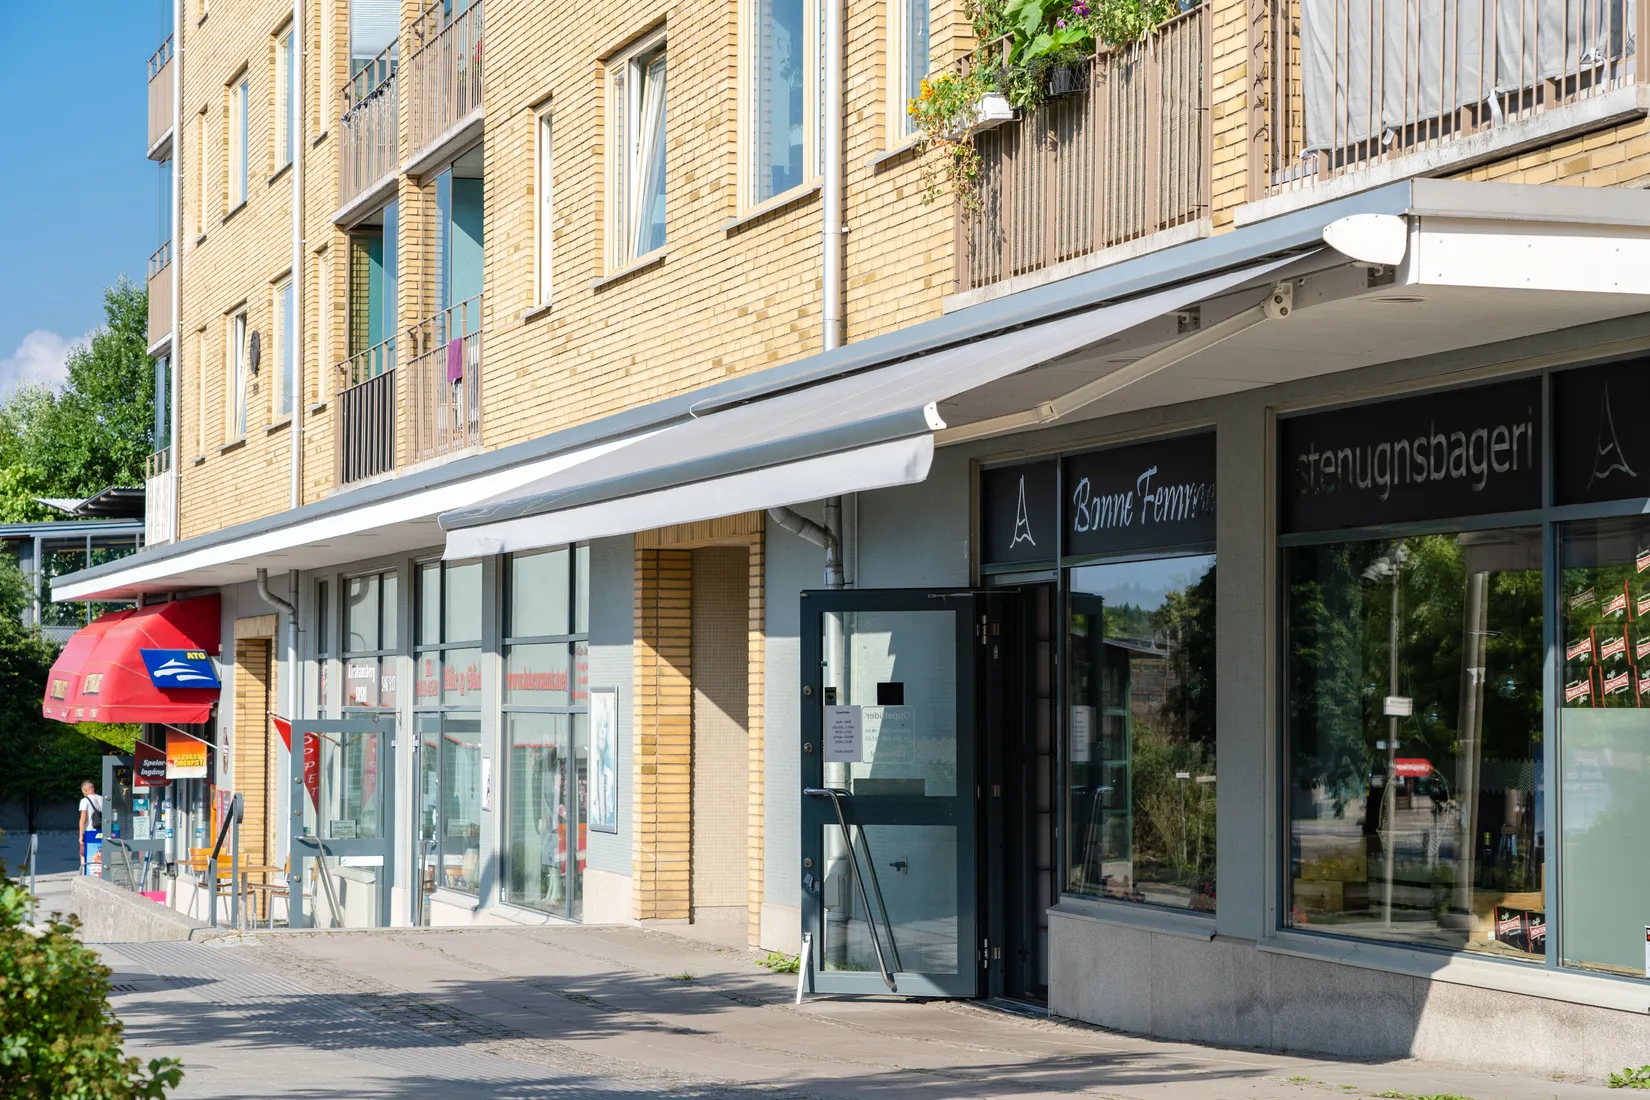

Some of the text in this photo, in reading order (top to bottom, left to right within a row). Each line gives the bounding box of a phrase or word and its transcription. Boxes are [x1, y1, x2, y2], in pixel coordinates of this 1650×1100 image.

[1296, 406, 1533, 502] stenugnsbageri
[1073, 477, 1133, 532] Bonne
[186, 652, 206, 660] ATG
[466, 663, 482, 690] Sån
[141, 768, 165, 776] ingång
